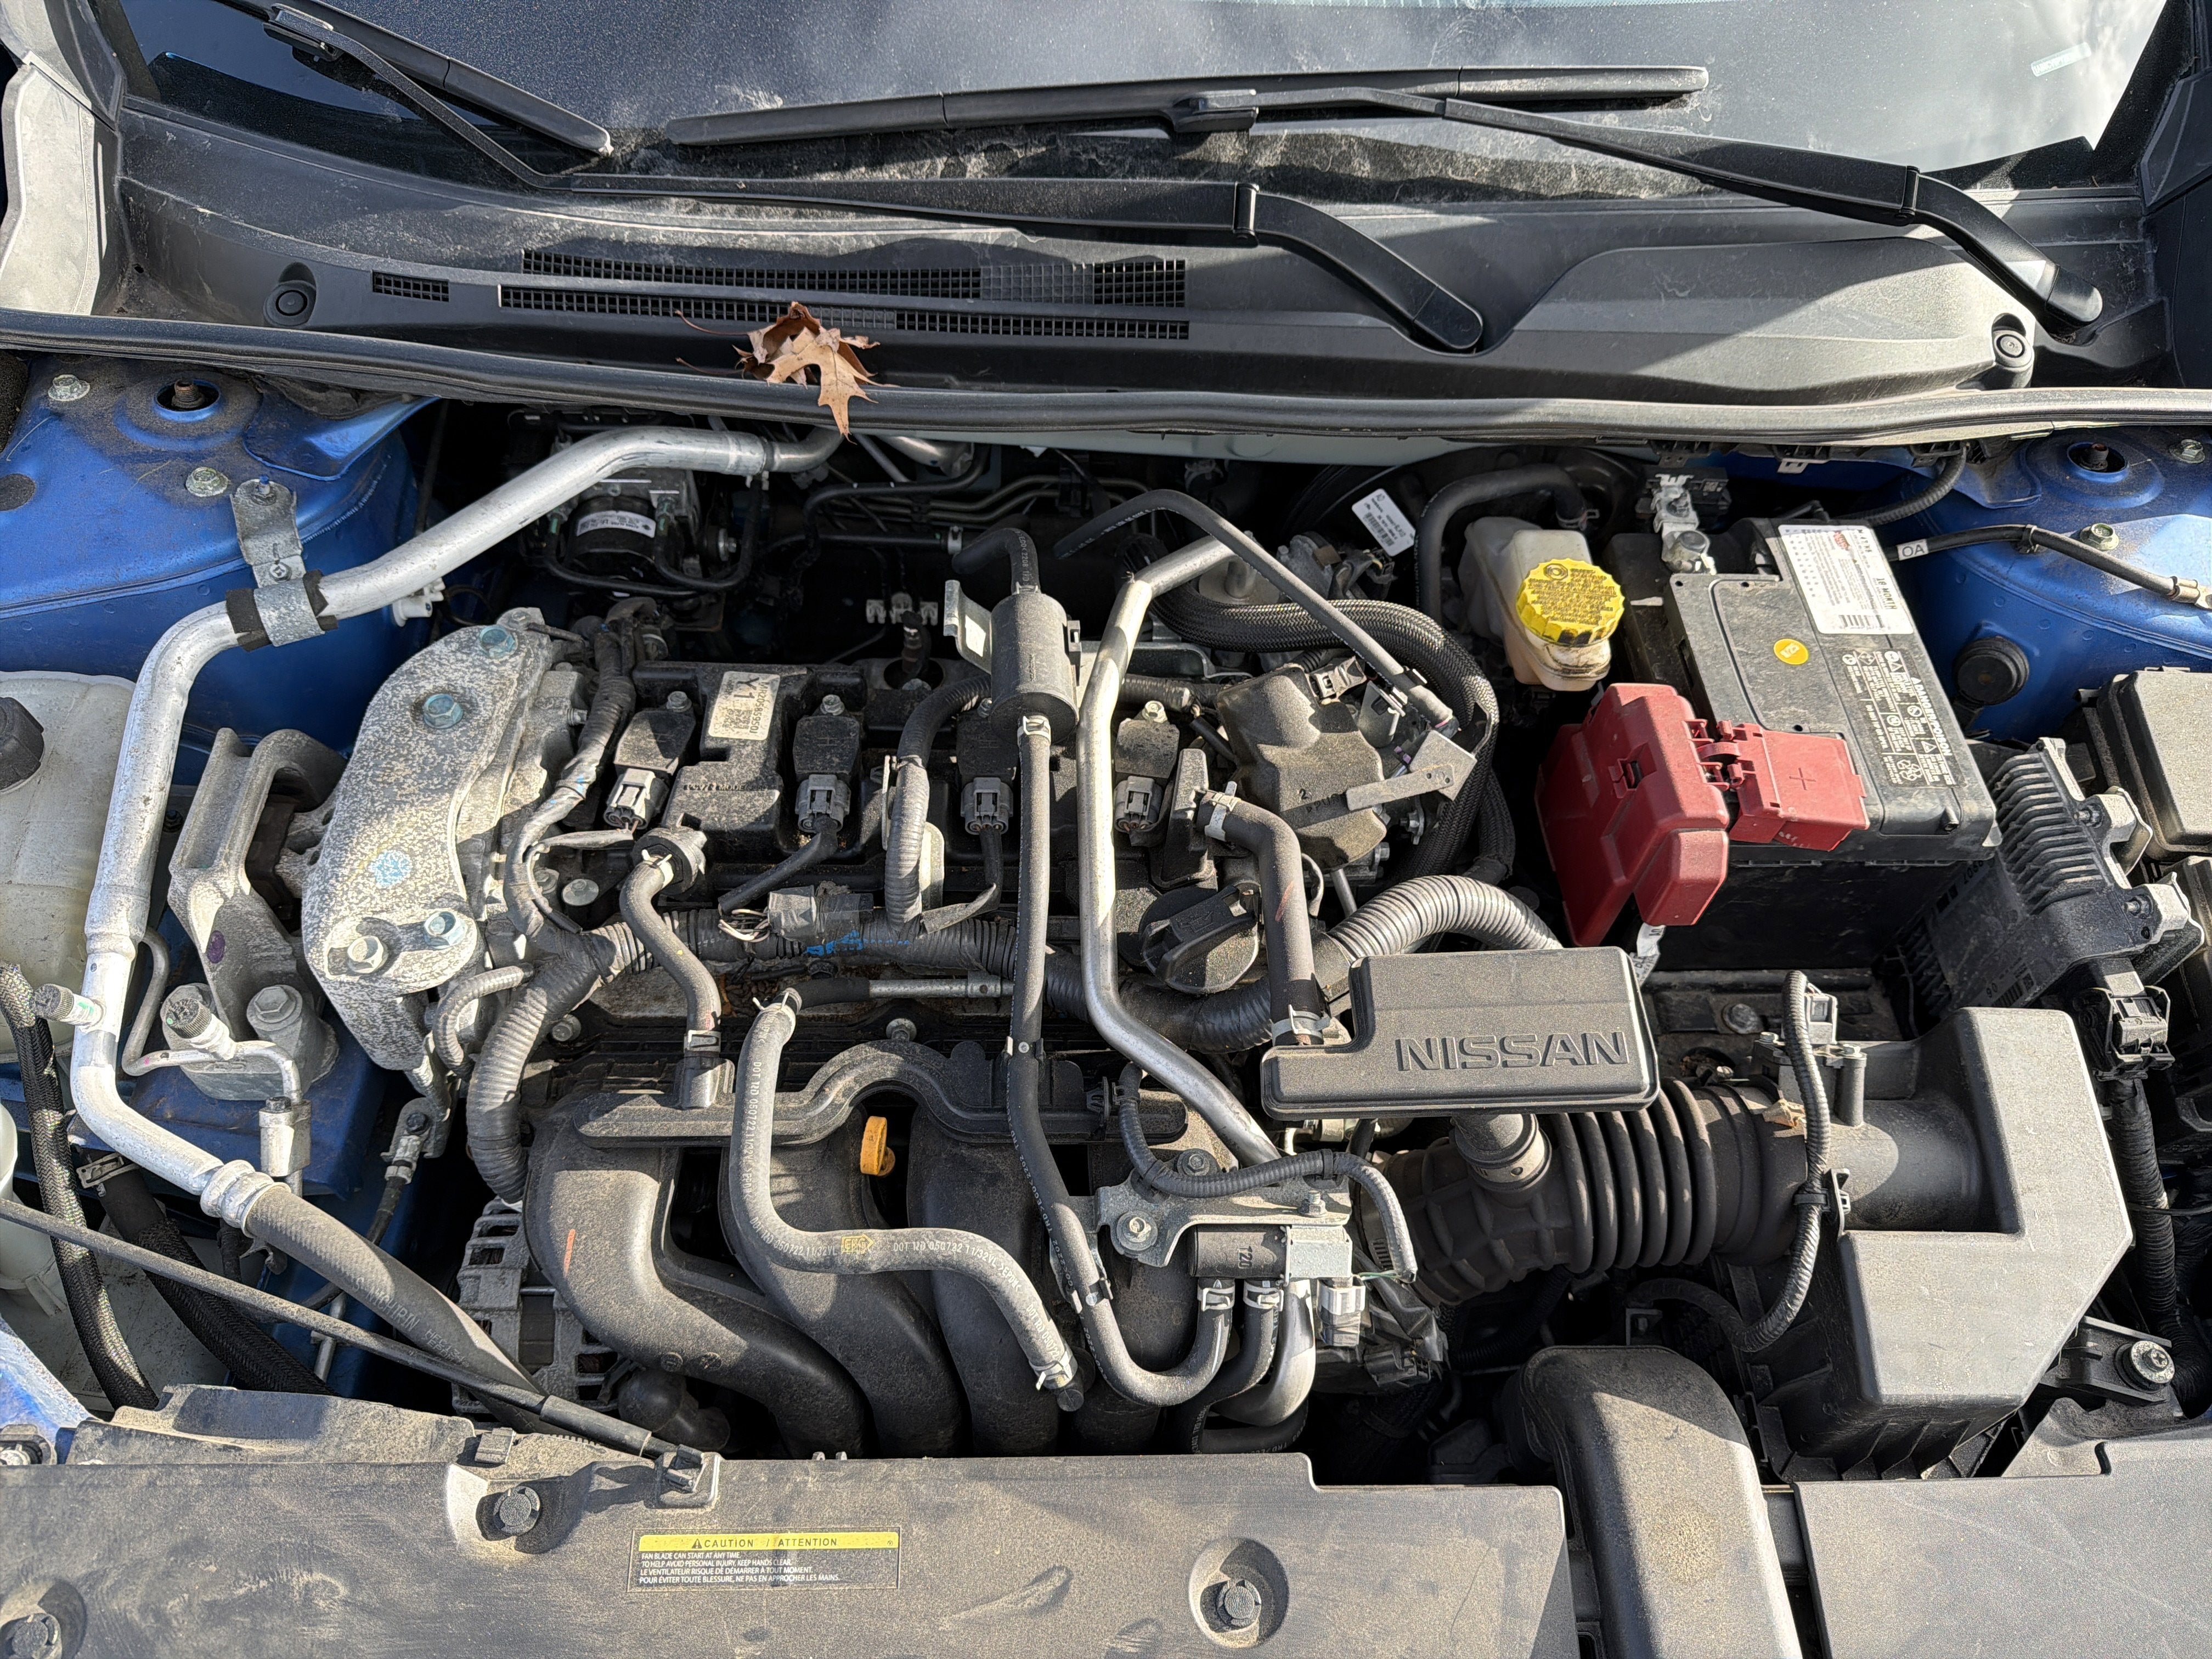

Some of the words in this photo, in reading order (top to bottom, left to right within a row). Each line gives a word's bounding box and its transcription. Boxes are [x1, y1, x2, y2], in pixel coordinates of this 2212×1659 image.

[1902, 544, 1925, 557] OA
[733, 677, 760, 699] Y1
[1395, 1031, 1629, 1071] NISSAN
[752, 1062, 761, 1077] DOT
[747, 1098, 758, 1129] 050722
[749, 1216, 761, 1232] DOT
[894, 1242, 909, 1252] DOT
[366, 1290, 420, 1331] NICHIRIN
[1026, 1304, 1039, 1320] DOT
[704, 1539, 754, 1548] CAUTION
[777, 1538, 837, 1547] ATTENTION
[725, 1566, 759, 1574] DÉMARRER
[659, 1575, 680, 1583] ÉVITER
[702, 1575, 736, 1583] BLESSURE,
